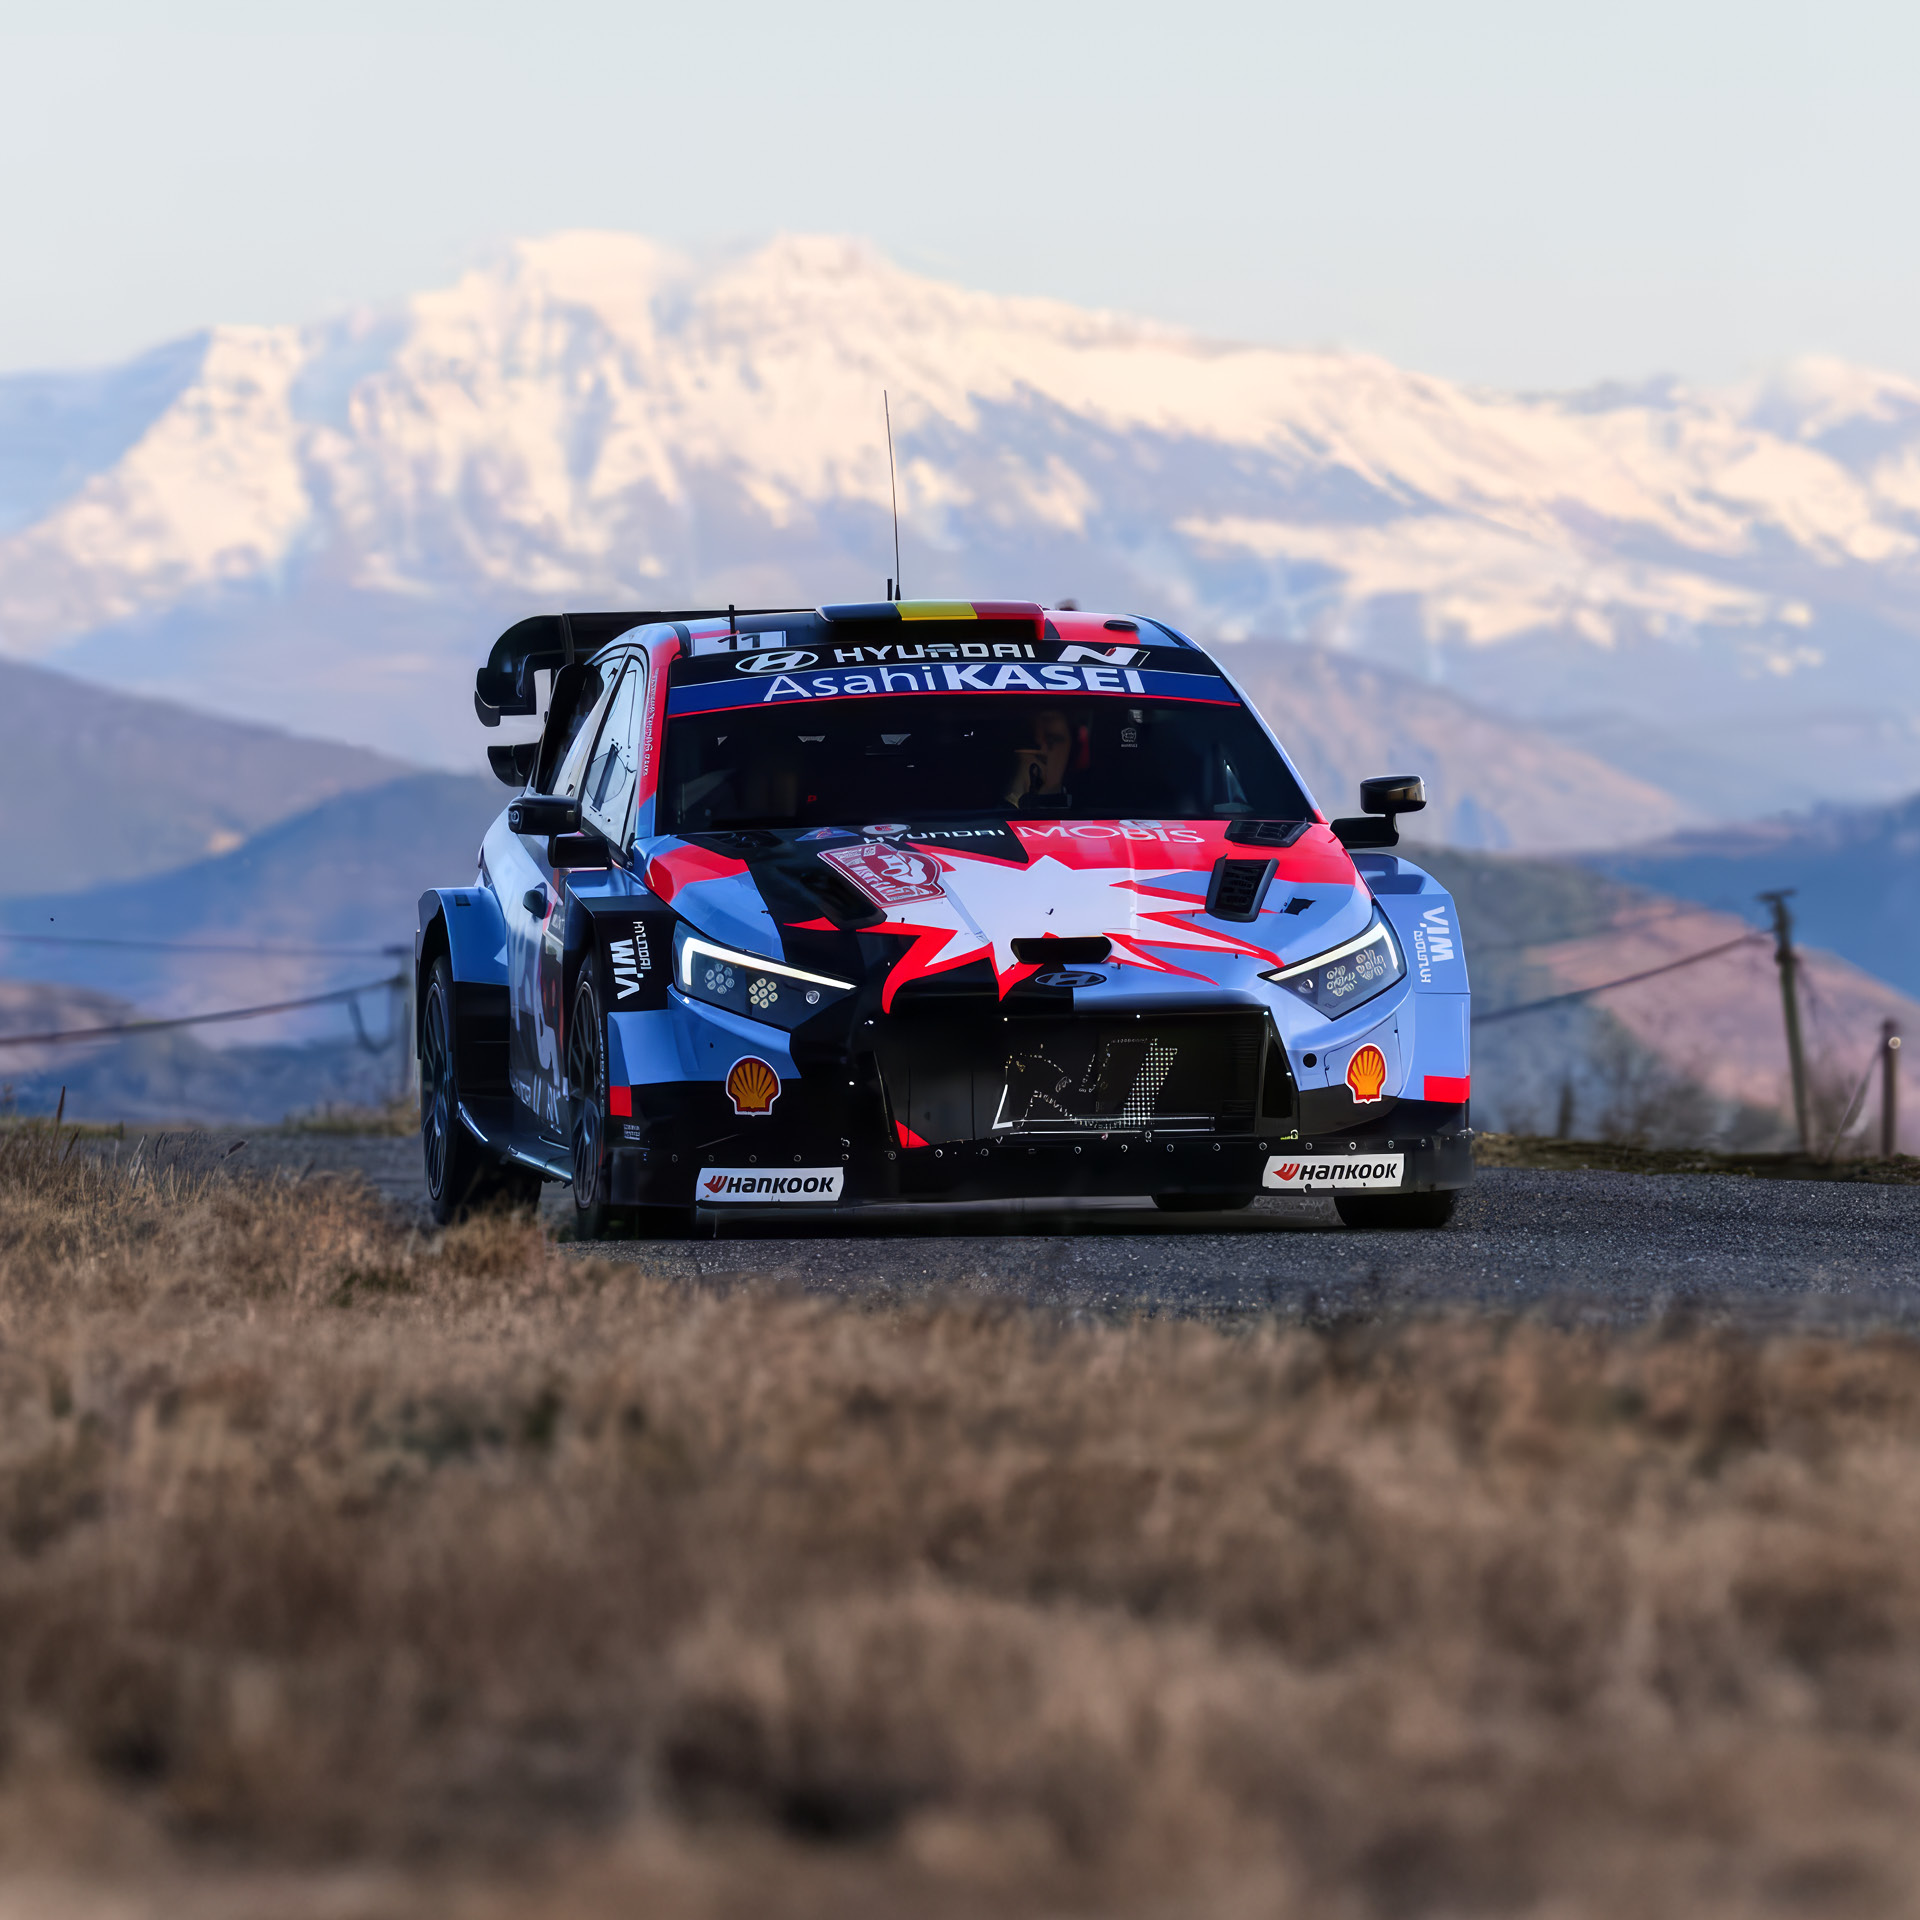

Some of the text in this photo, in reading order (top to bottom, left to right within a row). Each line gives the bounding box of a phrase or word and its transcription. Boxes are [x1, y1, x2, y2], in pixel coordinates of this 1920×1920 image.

[717, 634, 761, 650] 11
[834, 643, 1036, 663] HYUNDAI
[863, 828, 1006, 844] HYUNDAI
[1016, 825, 1206, 844] MOBIS
